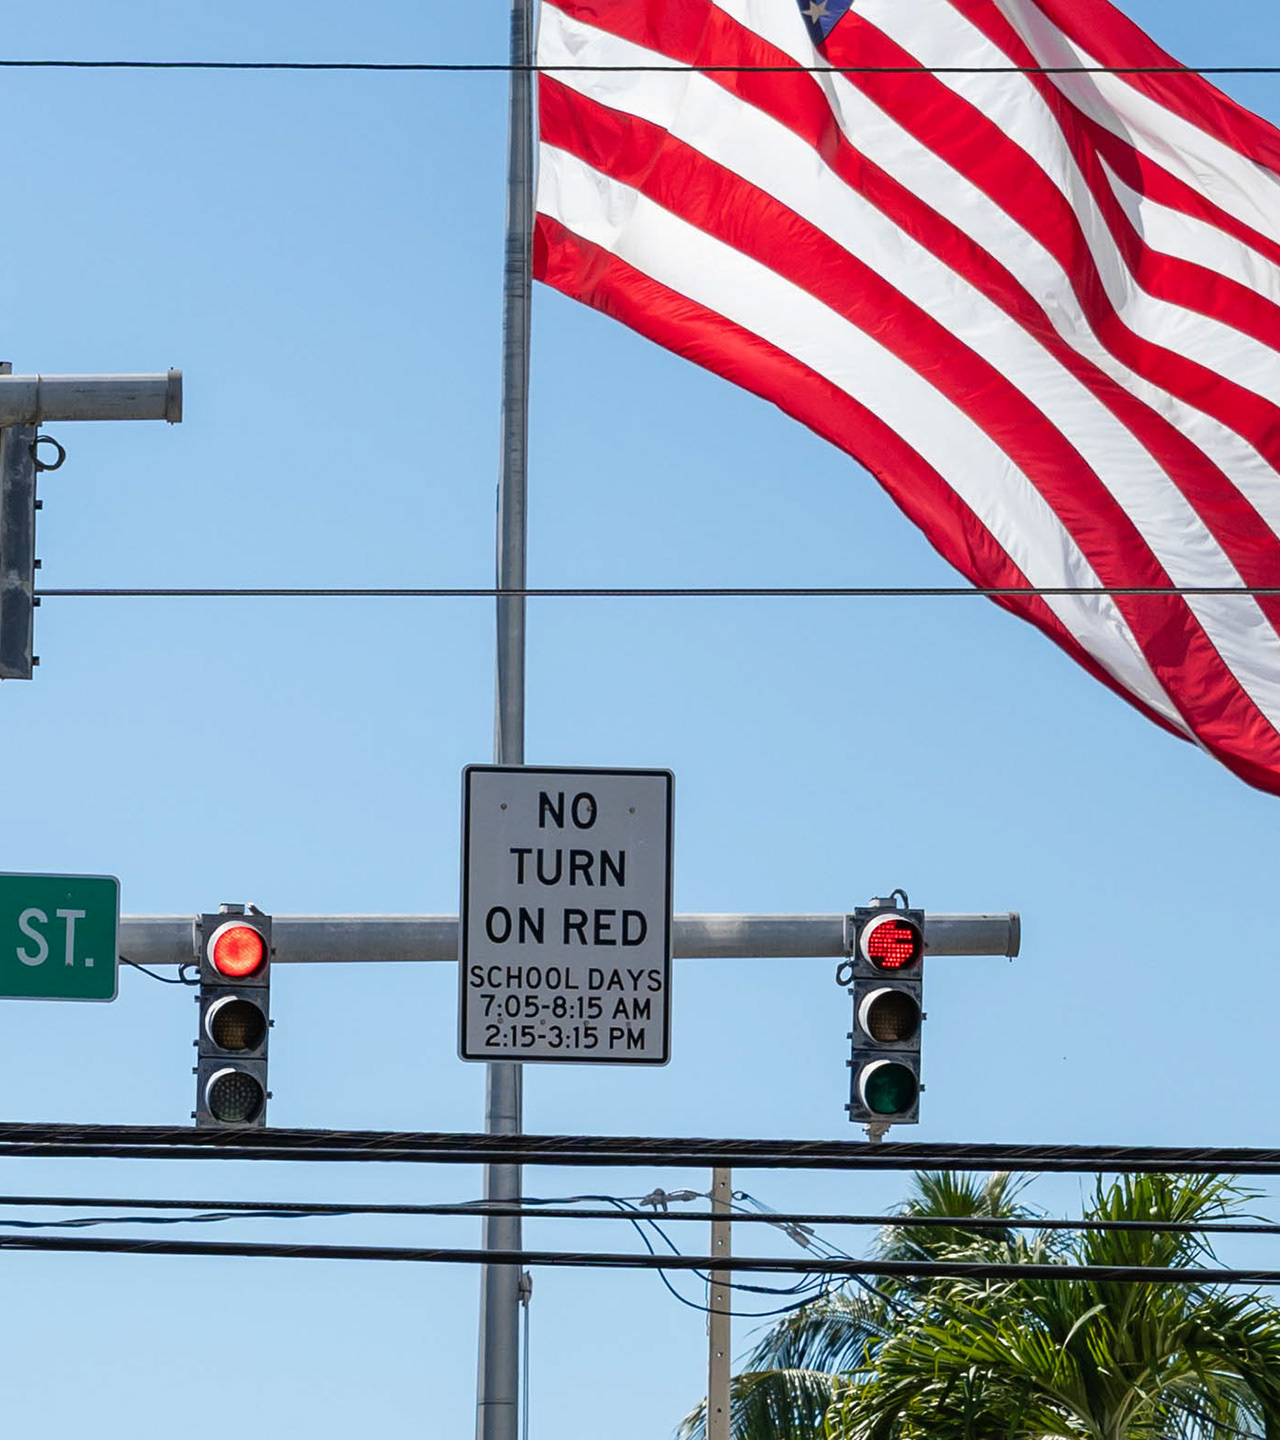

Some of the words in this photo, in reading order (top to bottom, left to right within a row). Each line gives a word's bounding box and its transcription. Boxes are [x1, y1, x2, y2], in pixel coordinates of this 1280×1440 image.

[538, 791, 598, 830] NO
[509, 847, 626, 887] TURN
[16, 907, 94, 967] ST.
[485, 905, 545, 945] ON
[563, 907, 648, 947] RED
[469, 965, 580, 990] SCHOOL
[587, 967, 663, 992] DAYS
[480, 994, 603, 1019] 7:05-8:15
[612, 997, 652, 1020] AM
[484, 1023, 599, 1049] 2:15-3:15
[609, 1026, 646, 1050] PM
